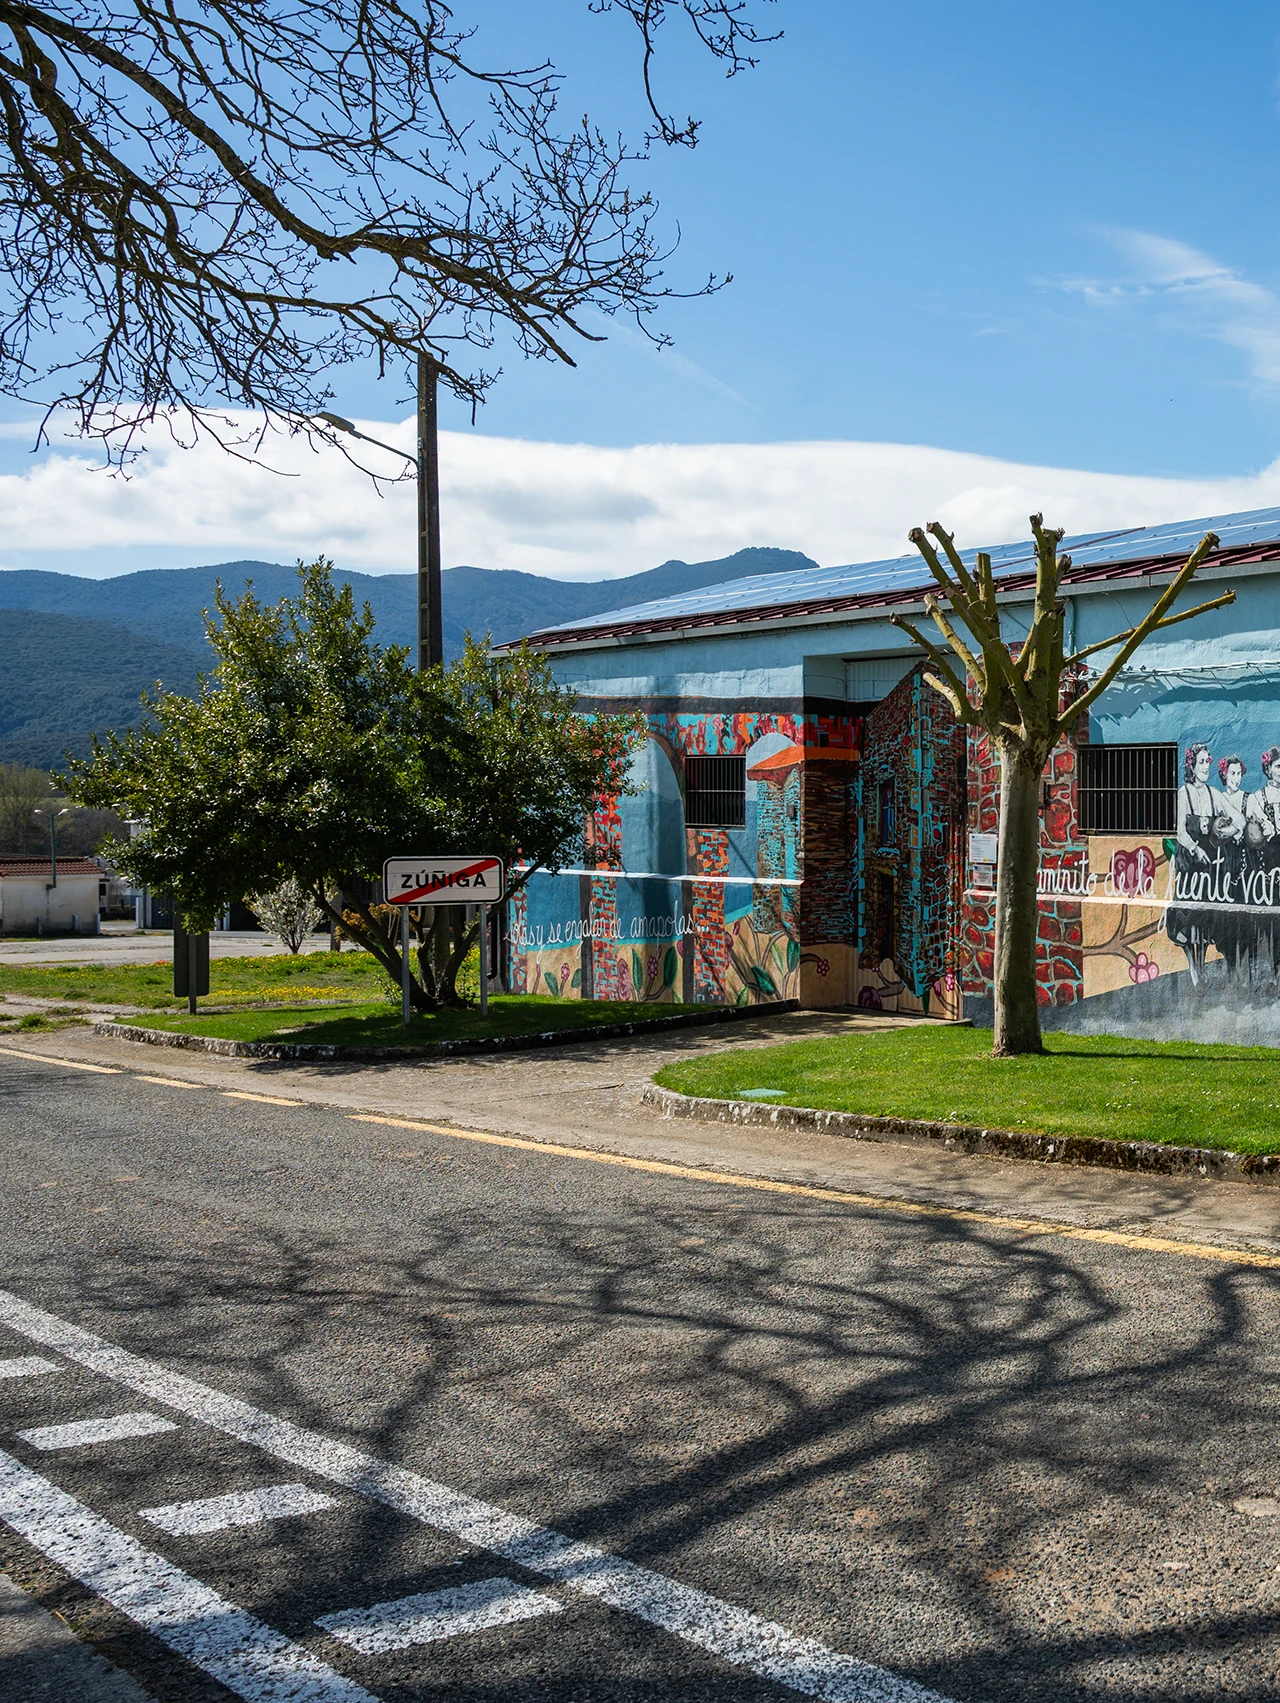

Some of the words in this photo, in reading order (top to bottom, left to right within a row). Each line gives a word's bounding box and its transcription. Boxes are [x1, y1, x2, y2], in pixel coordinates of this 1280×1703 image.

[401, 869, 487, 889] ZÚÑIGA
[1104, 848, 1131, 897] de
[1132, 848, 1157, 899] la
[1157, 852, 1235, 934] fuente
[546, 921, 563, 944] se
